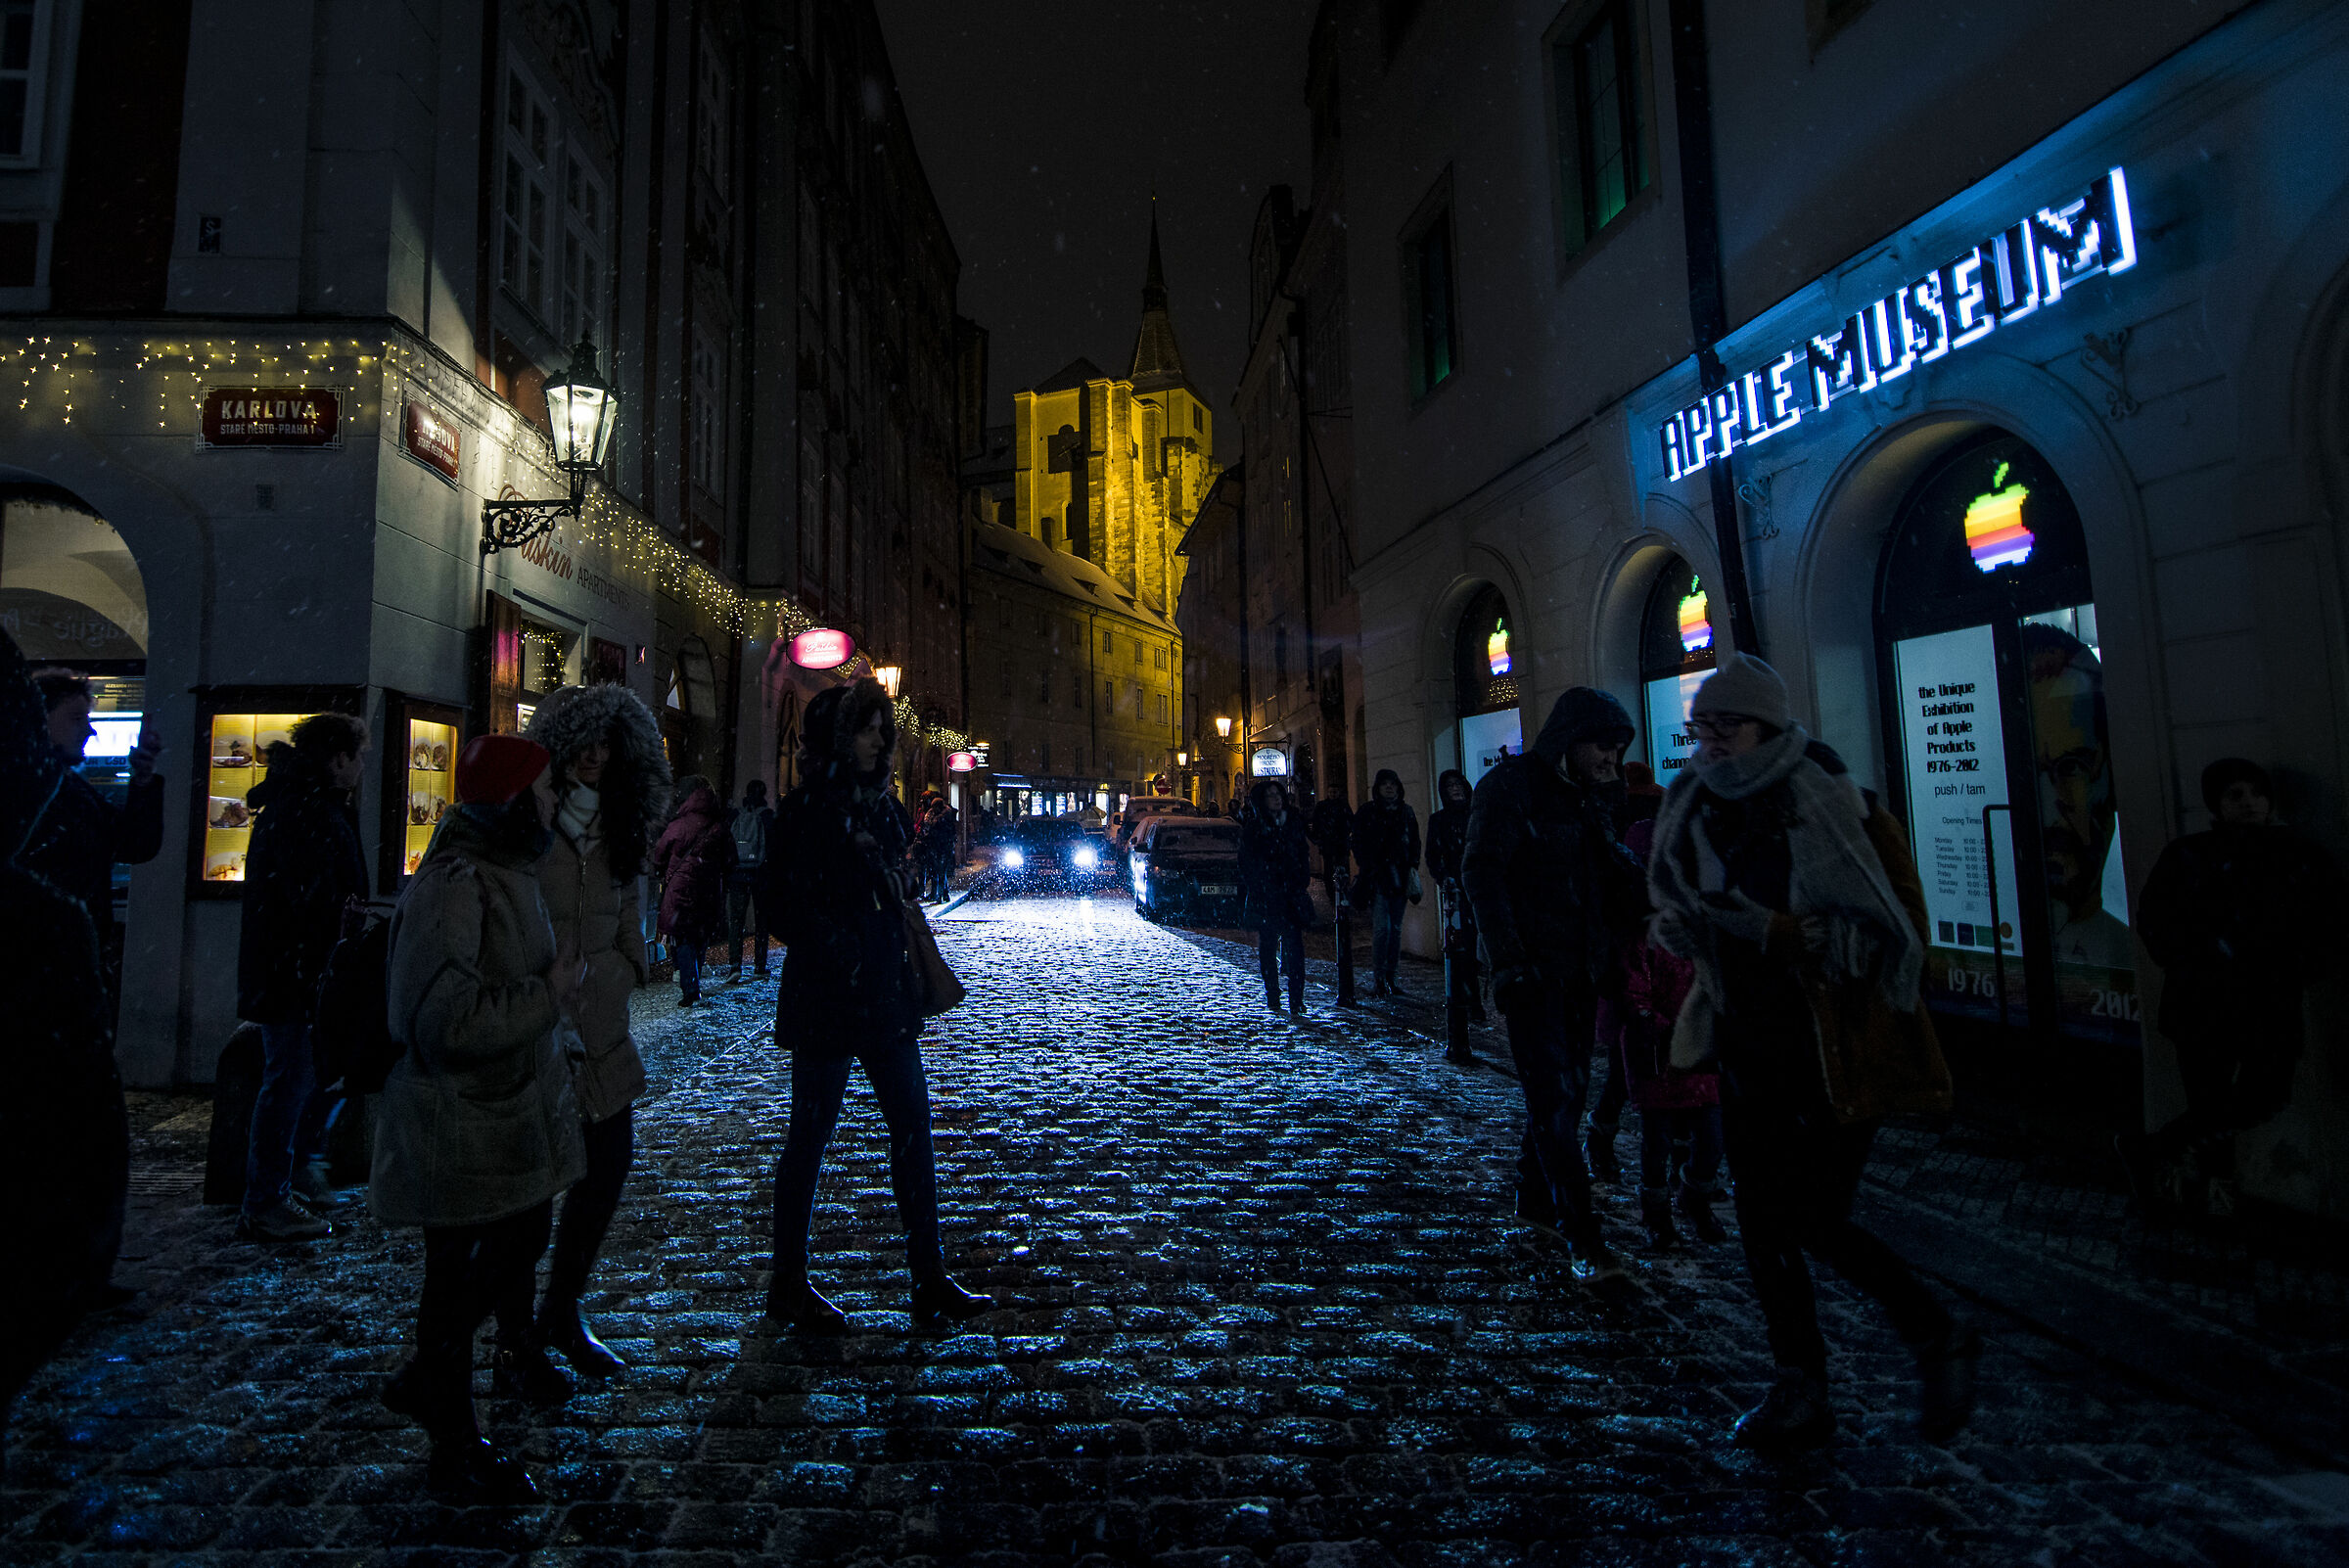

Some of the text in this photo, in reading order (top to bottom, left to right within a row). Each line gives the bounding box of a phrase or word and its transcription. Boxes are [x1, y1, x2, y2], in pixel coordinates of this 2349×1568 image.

[1661, 164, 2138, 483] APPLE MUSEUM
[222, 400, 317, 420] KARLOVA
[576, 567, 631, 611] APARTMENTS
[1918, 682, 1975, 699] the Unique
[1921, 702, 1974, 716] Exhibition
[1927, 720, 1973, 736] of Apple
[1926, 740, 1976, 754] Products
[1926, 759, 1980, 773] 1976-2012
[1934, 783, 1958, 798] push
[1966, 783, 1986, 795] tam
[1942, 816, 1964, 825] Opening
[1948, 967, 1997, 998] 1976
